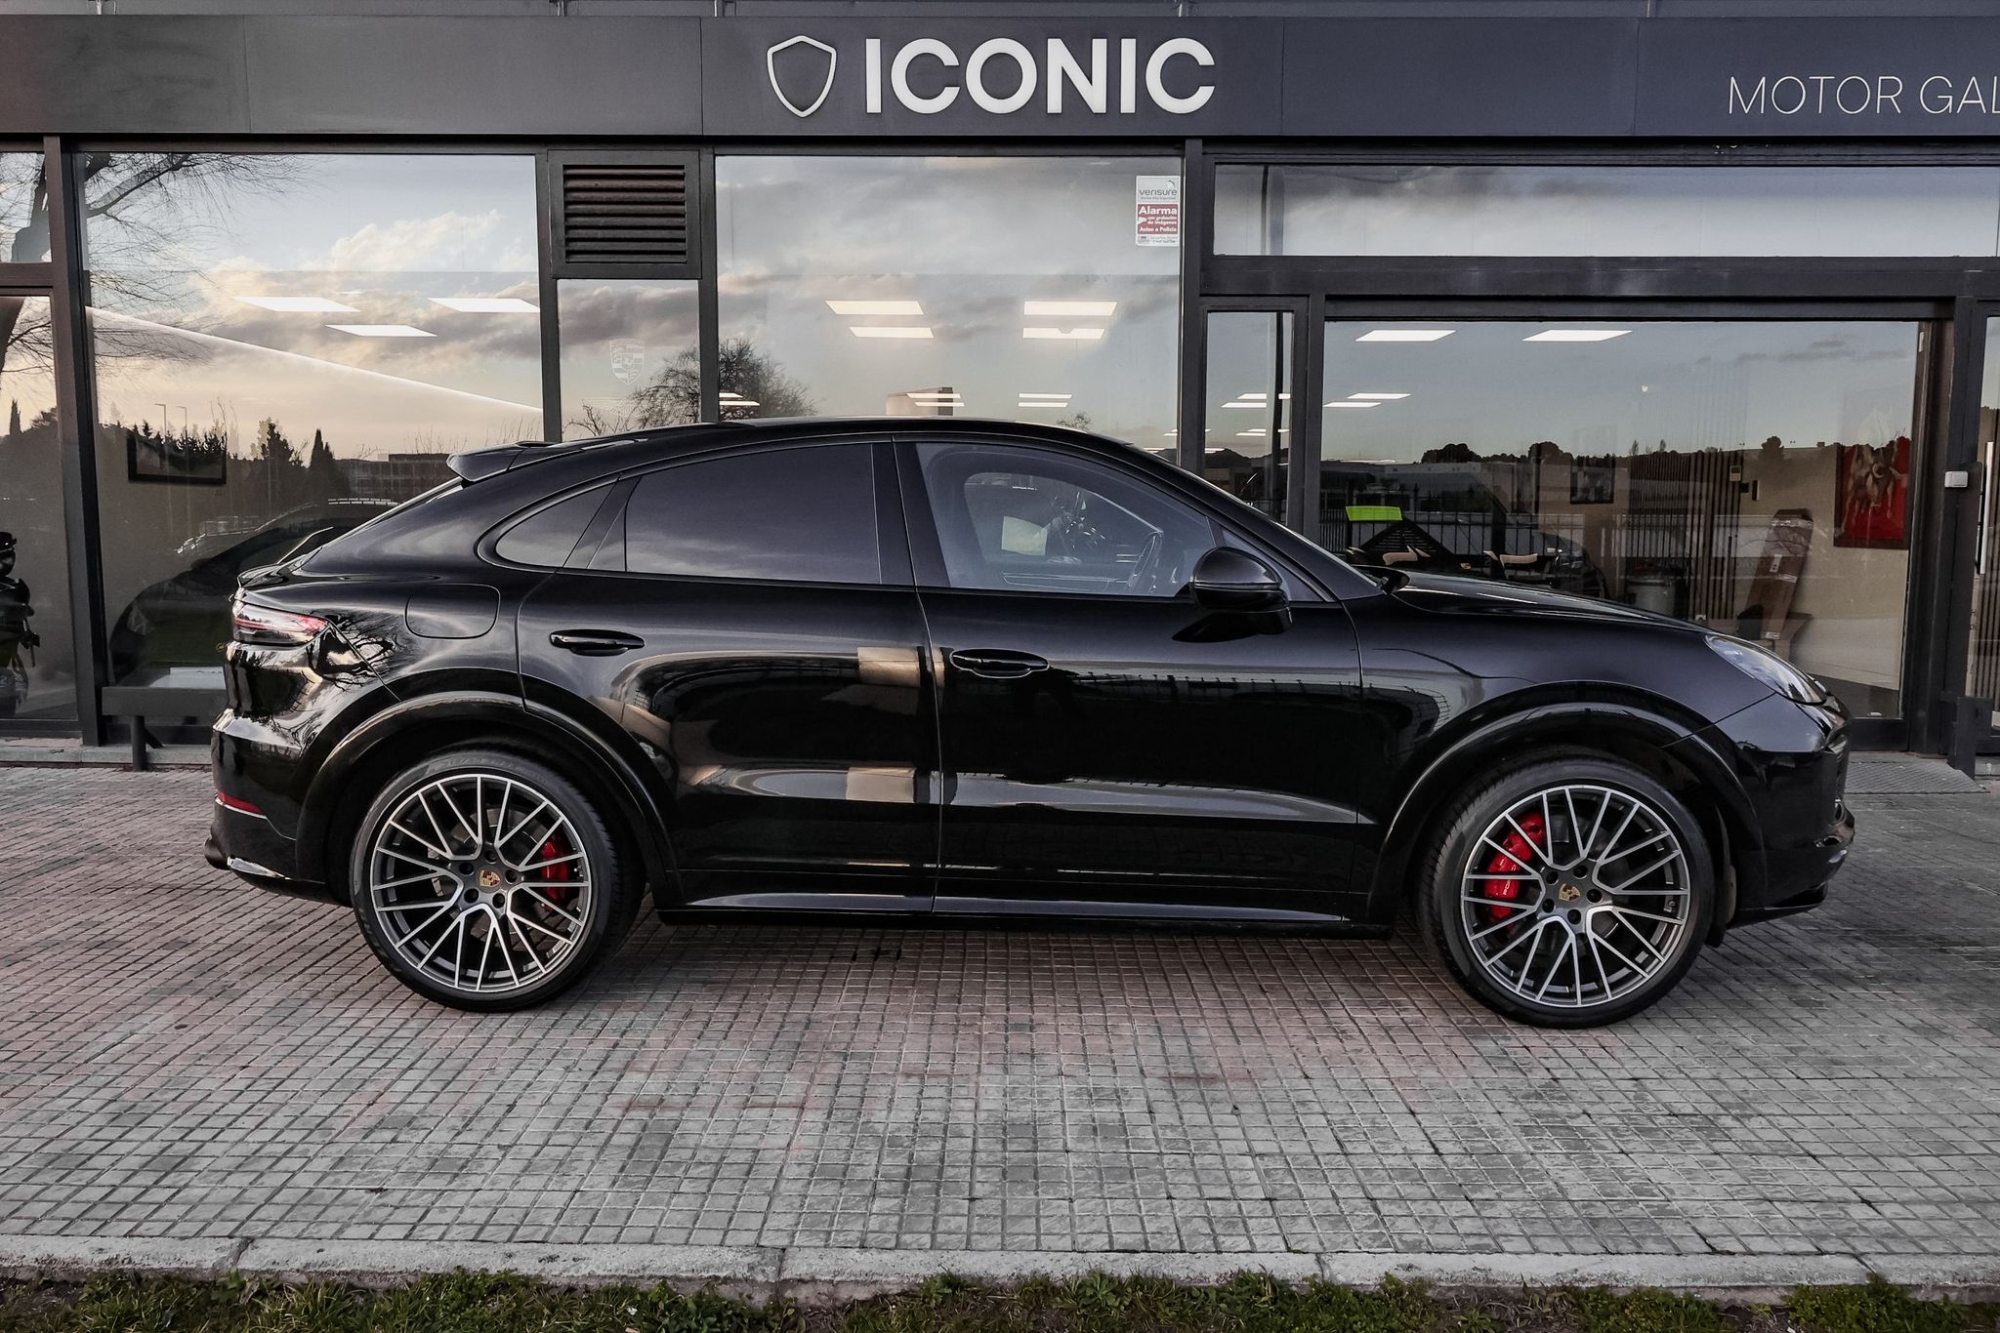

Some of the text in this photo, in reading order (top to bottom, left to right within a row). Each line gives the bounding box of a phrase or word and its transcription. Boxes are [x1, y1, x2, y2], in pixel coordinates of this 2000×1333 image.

[865, 37, 1216, 114] ICONIC
[1728, 75, 2000, 114] MOTOR GAL
[1138, 205, 1178, 215] Alarma
